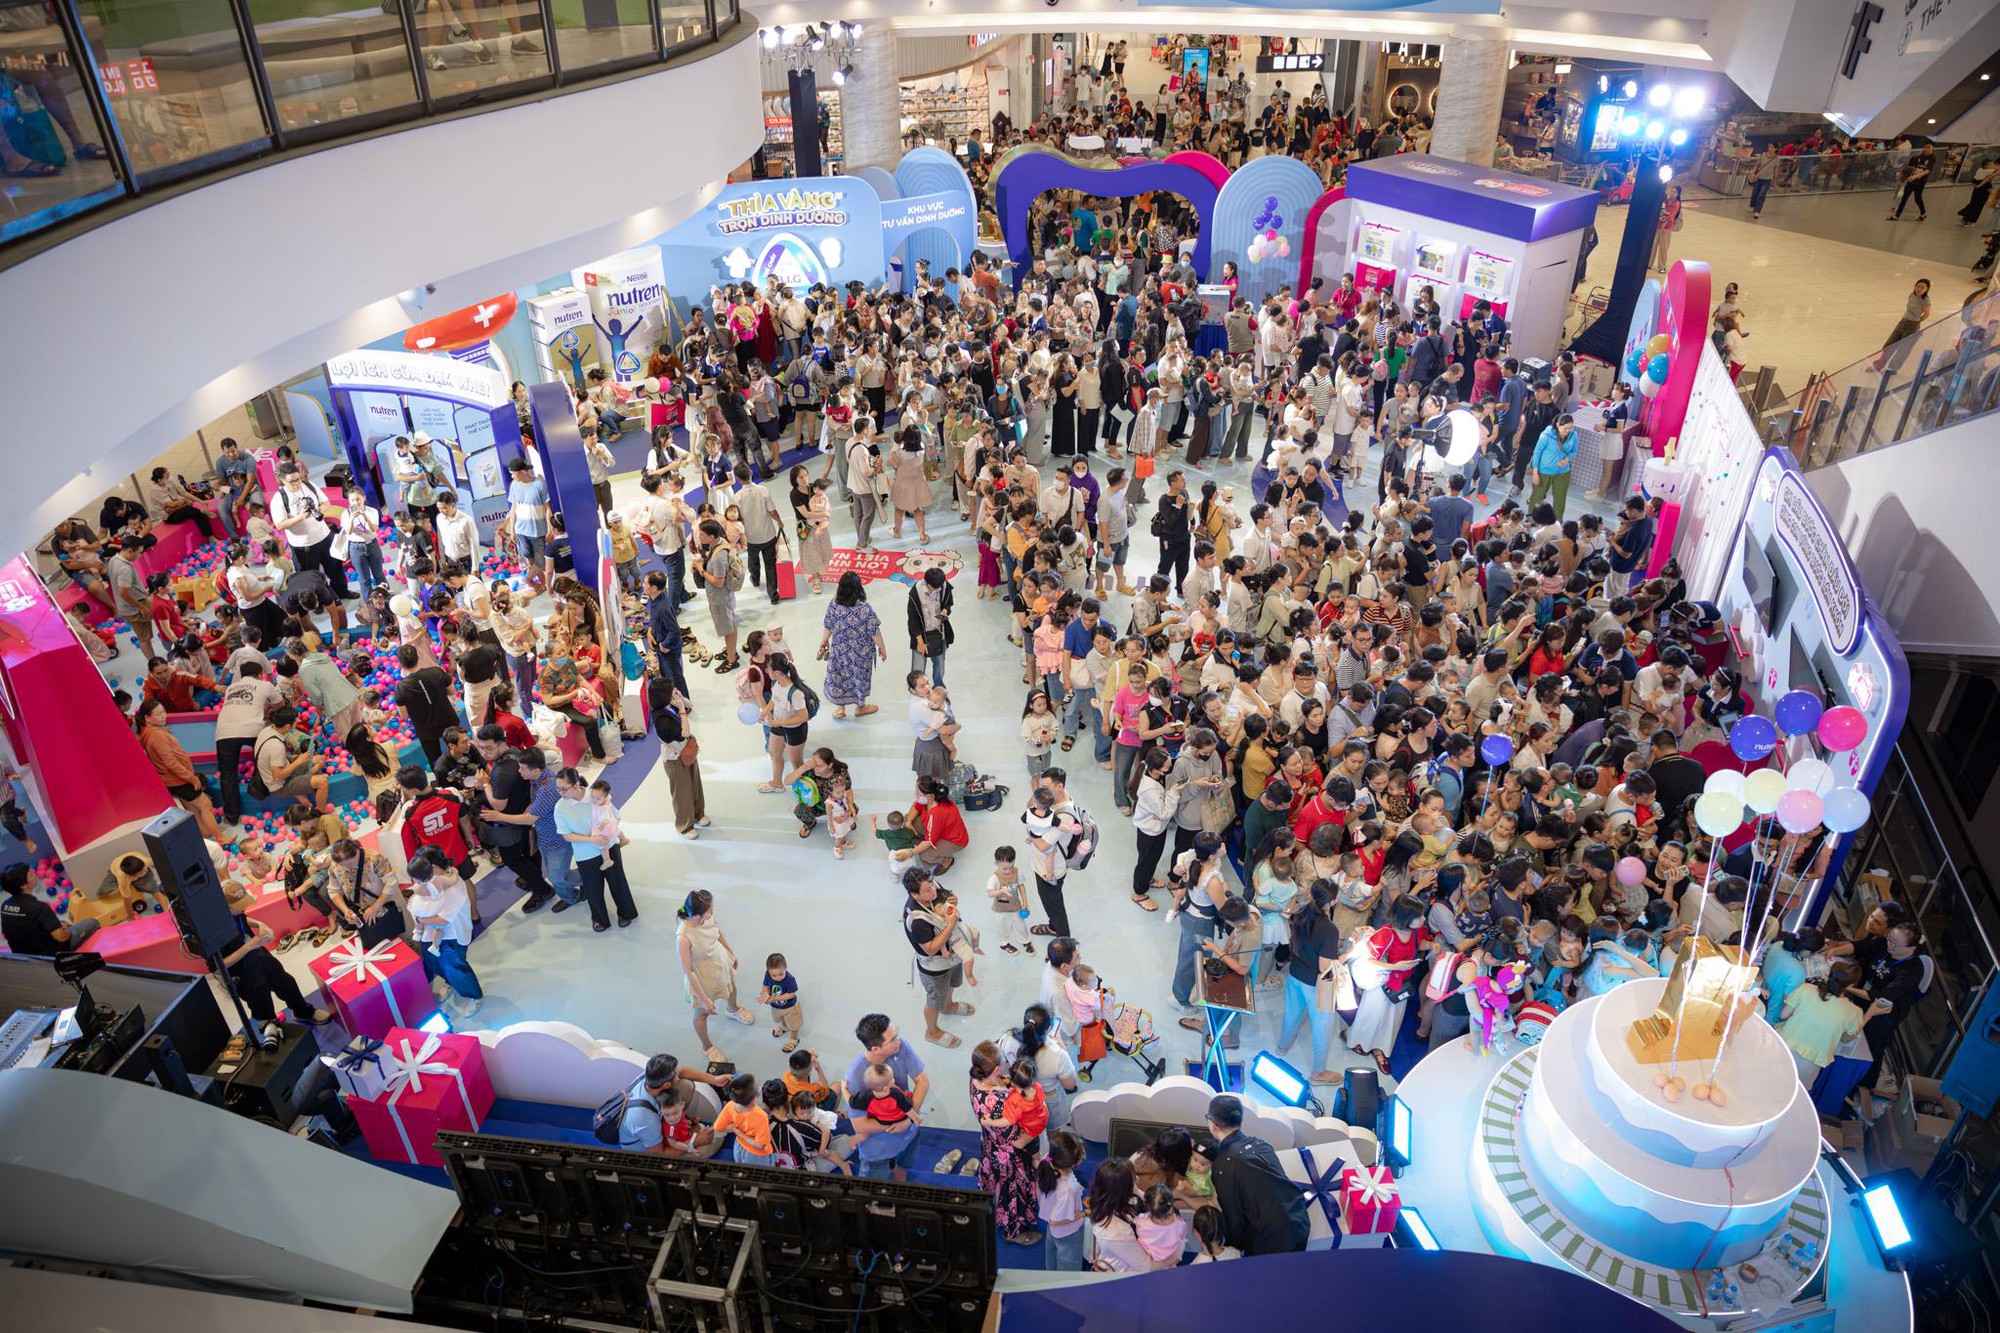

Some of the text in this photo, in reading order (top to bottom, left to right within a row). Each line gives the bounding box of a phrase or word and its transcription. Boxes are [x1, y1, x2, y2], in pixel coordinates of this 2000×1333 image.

[1399, 55, 1441, 68] SAIGO
[907, 200, 945, 216] KHU VỰC
[720, 217, 759, 233] TRỌN
[761, 212, 793, 226] DINH
[882, 219, 895, 228] TƯ
[896, 215, 915, 226] VẤN
[916, 213, 937, 224] DINH
[607, 283, 660, 307] nutren
[554, 310, 584, 325] nutren
[331, 361, 359, 378] LỢI
[360, 360, 389, 378] ÍCH
[370, 405, 398, 417] nutren
[481, 509, 510, 523] nutre
[828, 559, 852, 567] NH
[831, 552, 851, 560] NA
[423, 807, 448, 832] ST
